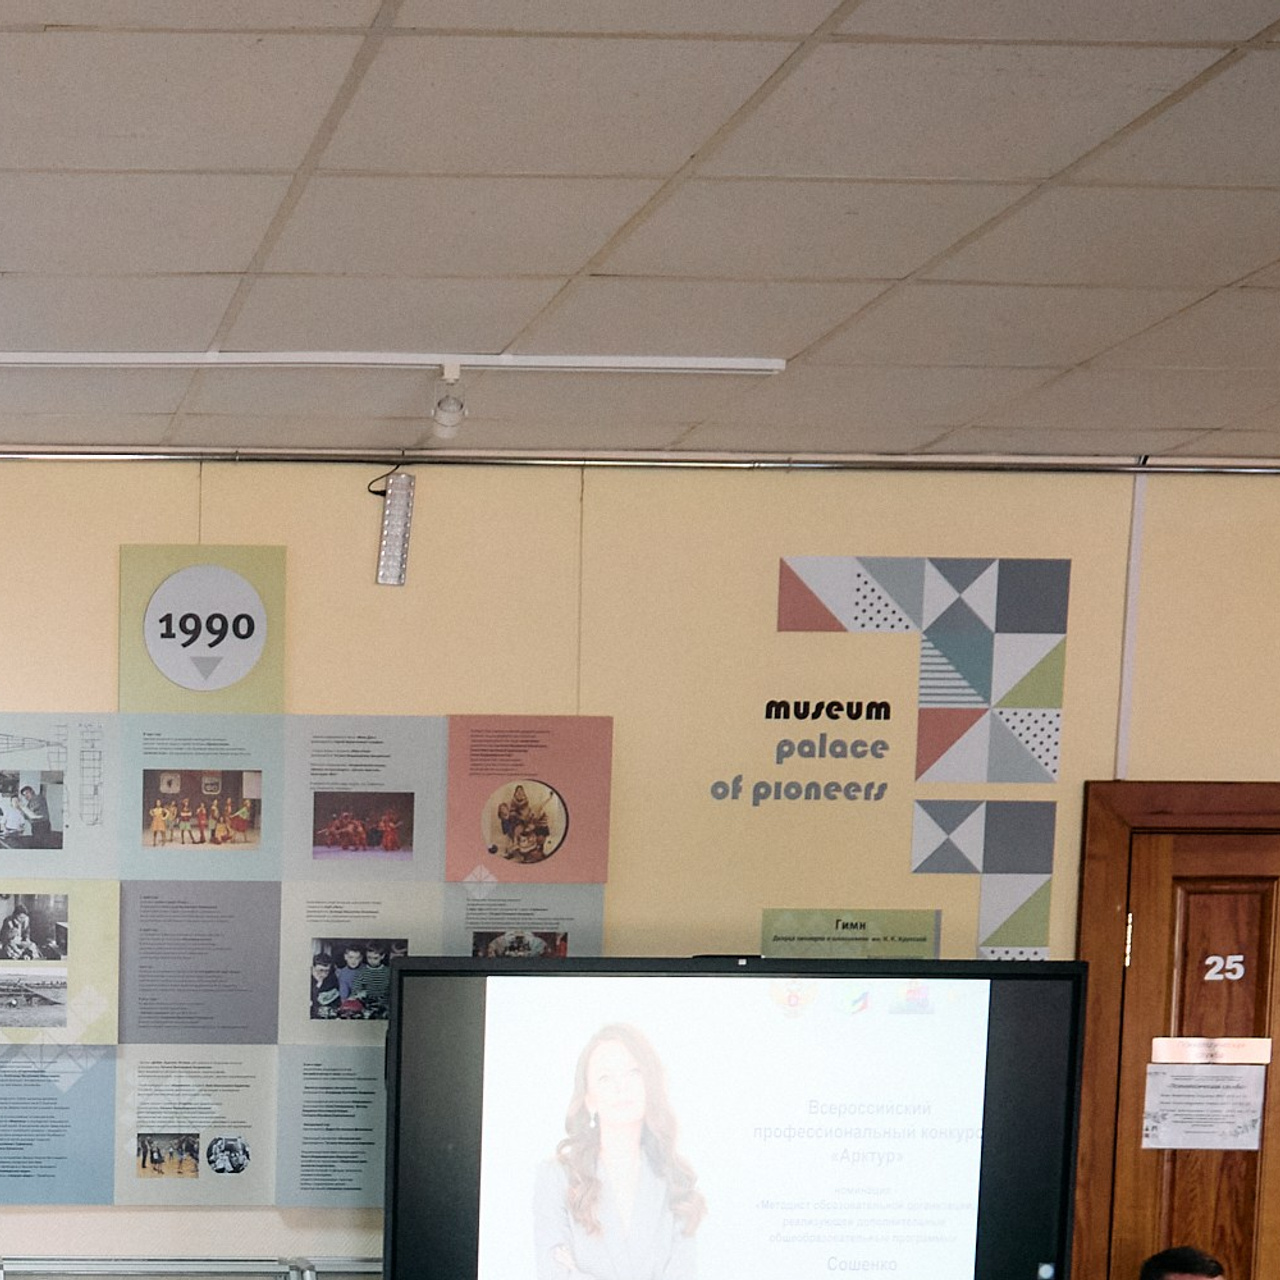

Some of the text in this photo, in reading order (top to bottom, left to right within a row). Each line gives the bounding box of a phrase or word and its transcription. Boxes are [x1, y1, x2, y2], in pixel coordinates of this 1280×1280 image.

[158, 611, 256, 648] 1990
[765, 697, 892, 721] museum
[776, 732, 890, 764] palace
[710, 775, 887, 807] of pioneers
[835, 918, 867, 931] Гимн
[1204, 955, 1245, 981] 25
[808, 1099, 932, 1118] Всероссийский
[754, 1125, 916, 1142] профессиональный
[831, 1148, 903, 1166] «Арктур»
[827, 1256, 898, 1272] Сошенко
